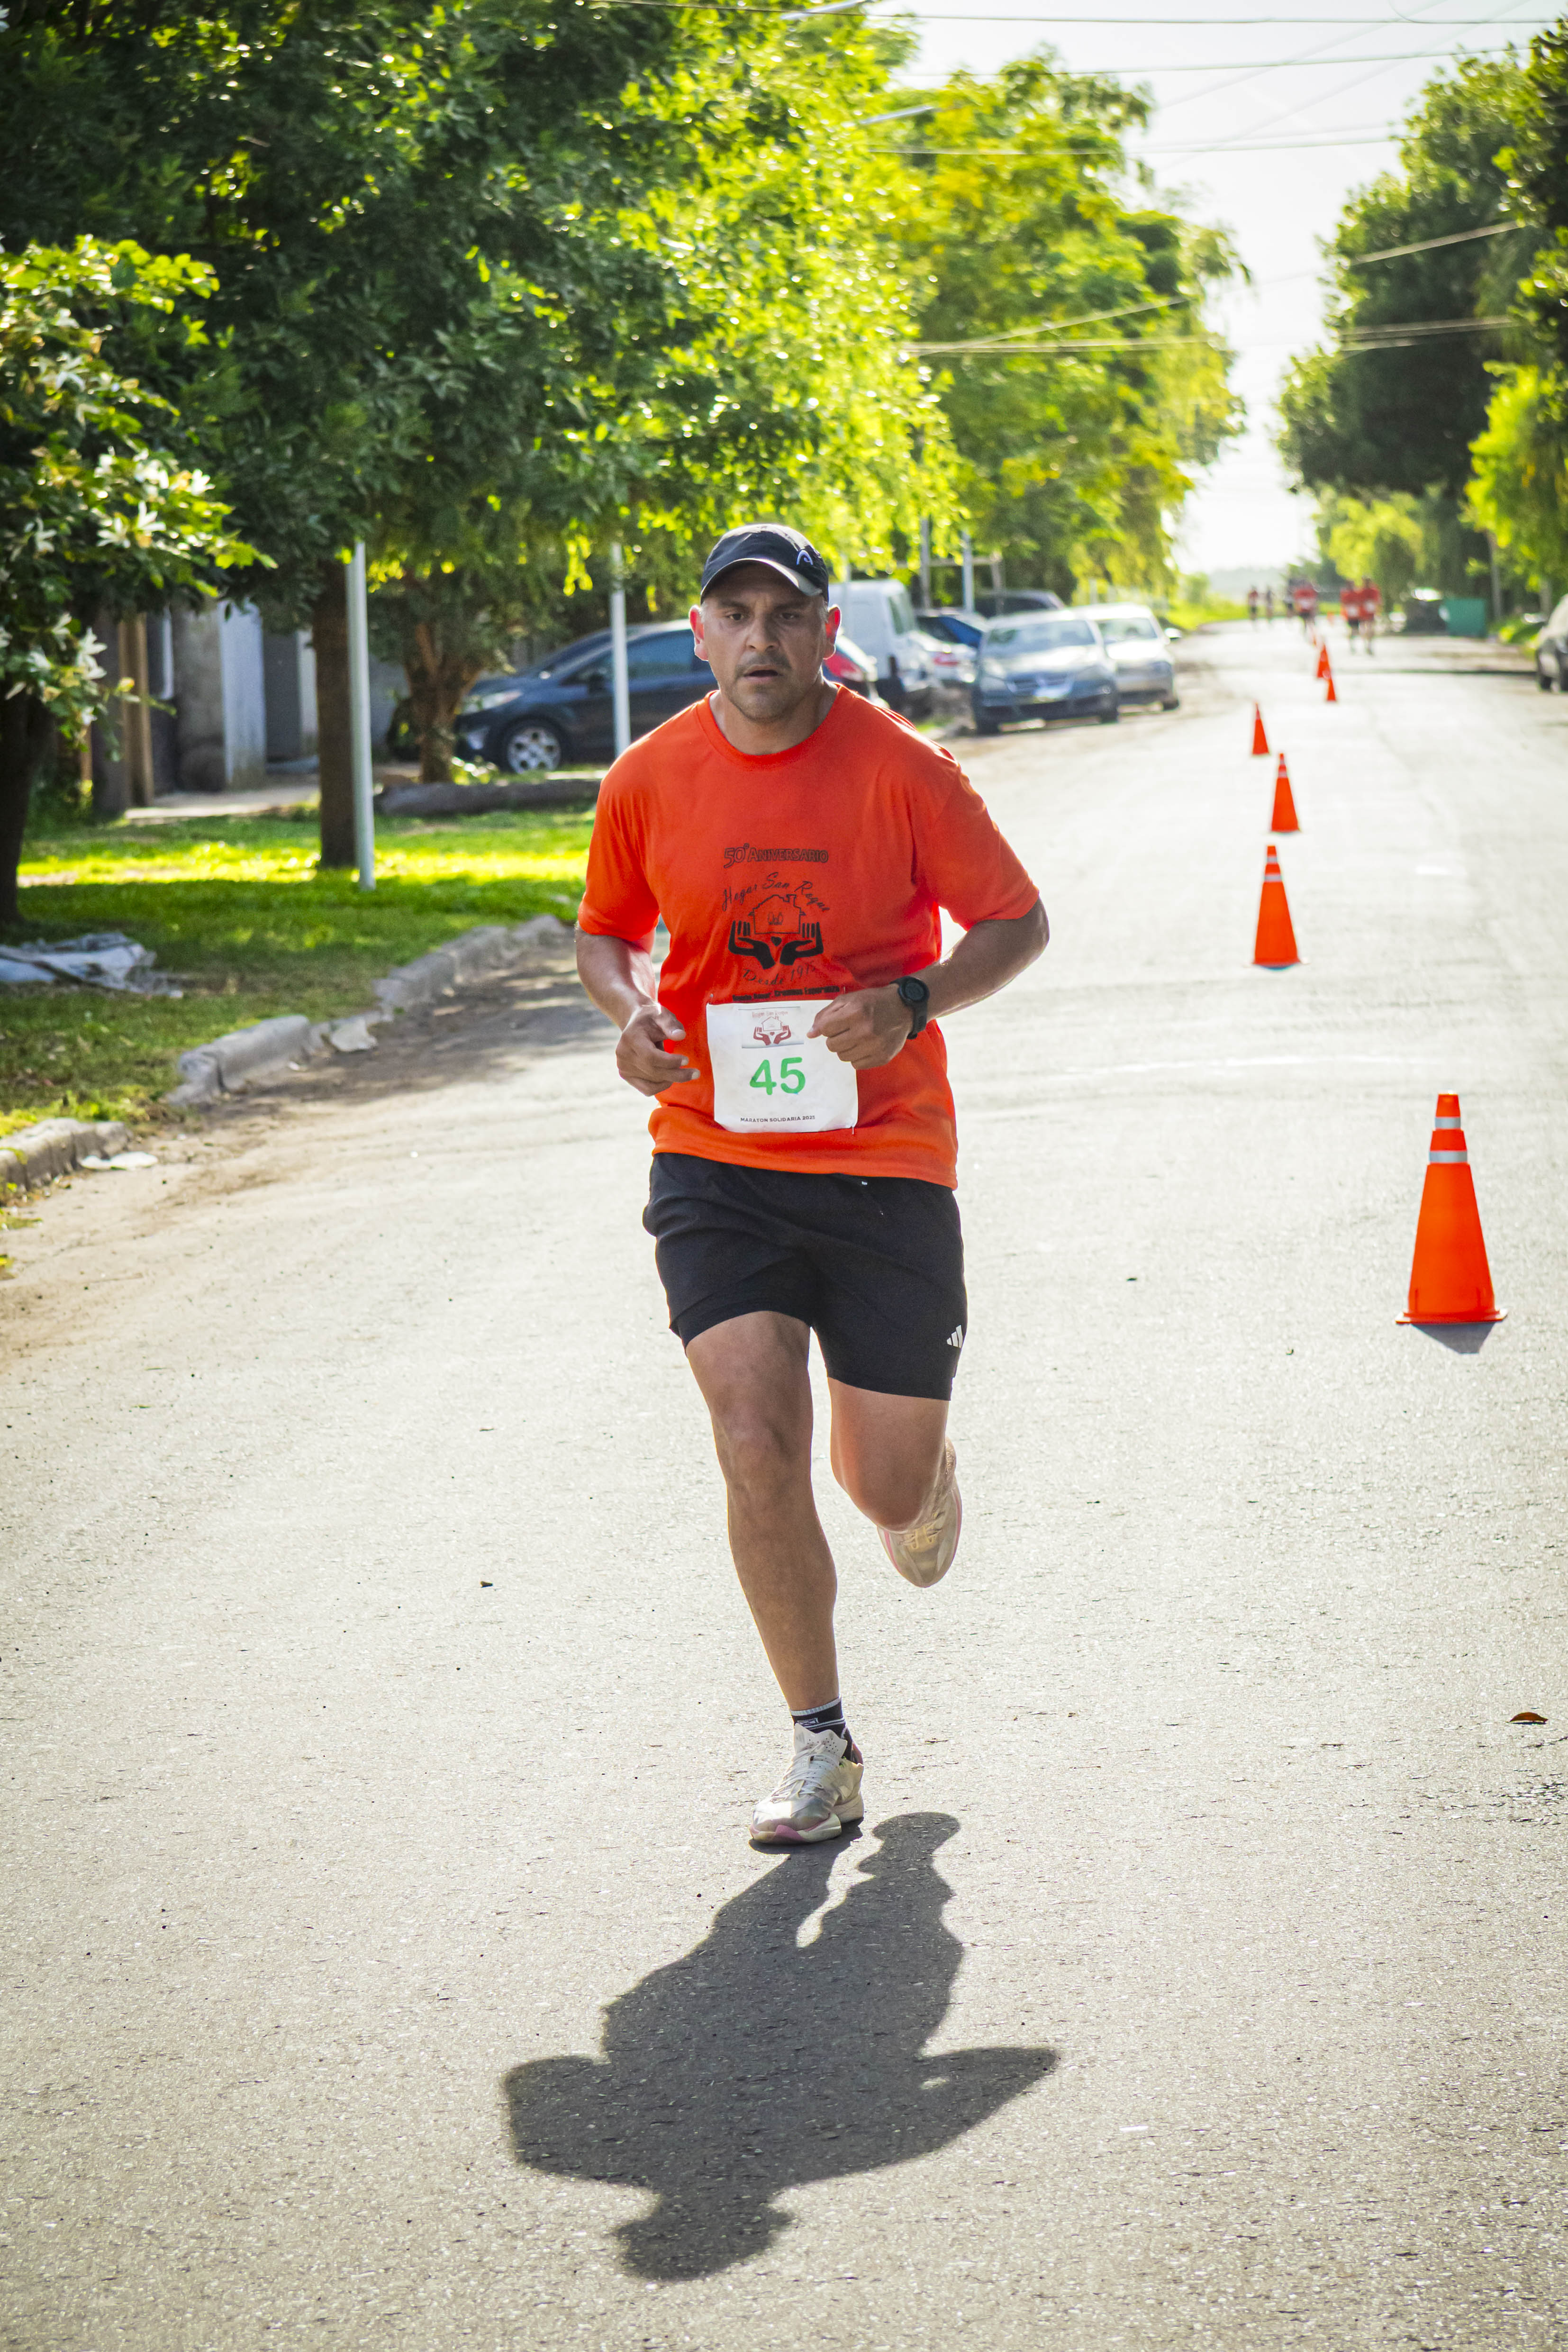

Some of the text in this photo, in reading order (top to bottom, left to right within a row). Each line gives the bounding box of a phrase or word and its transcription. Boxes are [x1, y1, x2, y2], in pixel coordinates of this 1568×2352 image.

[747, 847, 828, 863] ANIVERSARIO
[722, 872, 830, 912] Hogar San Roque
[743, 969, 784, 986] Desde
[749, 1057, 806, 1095] 45
